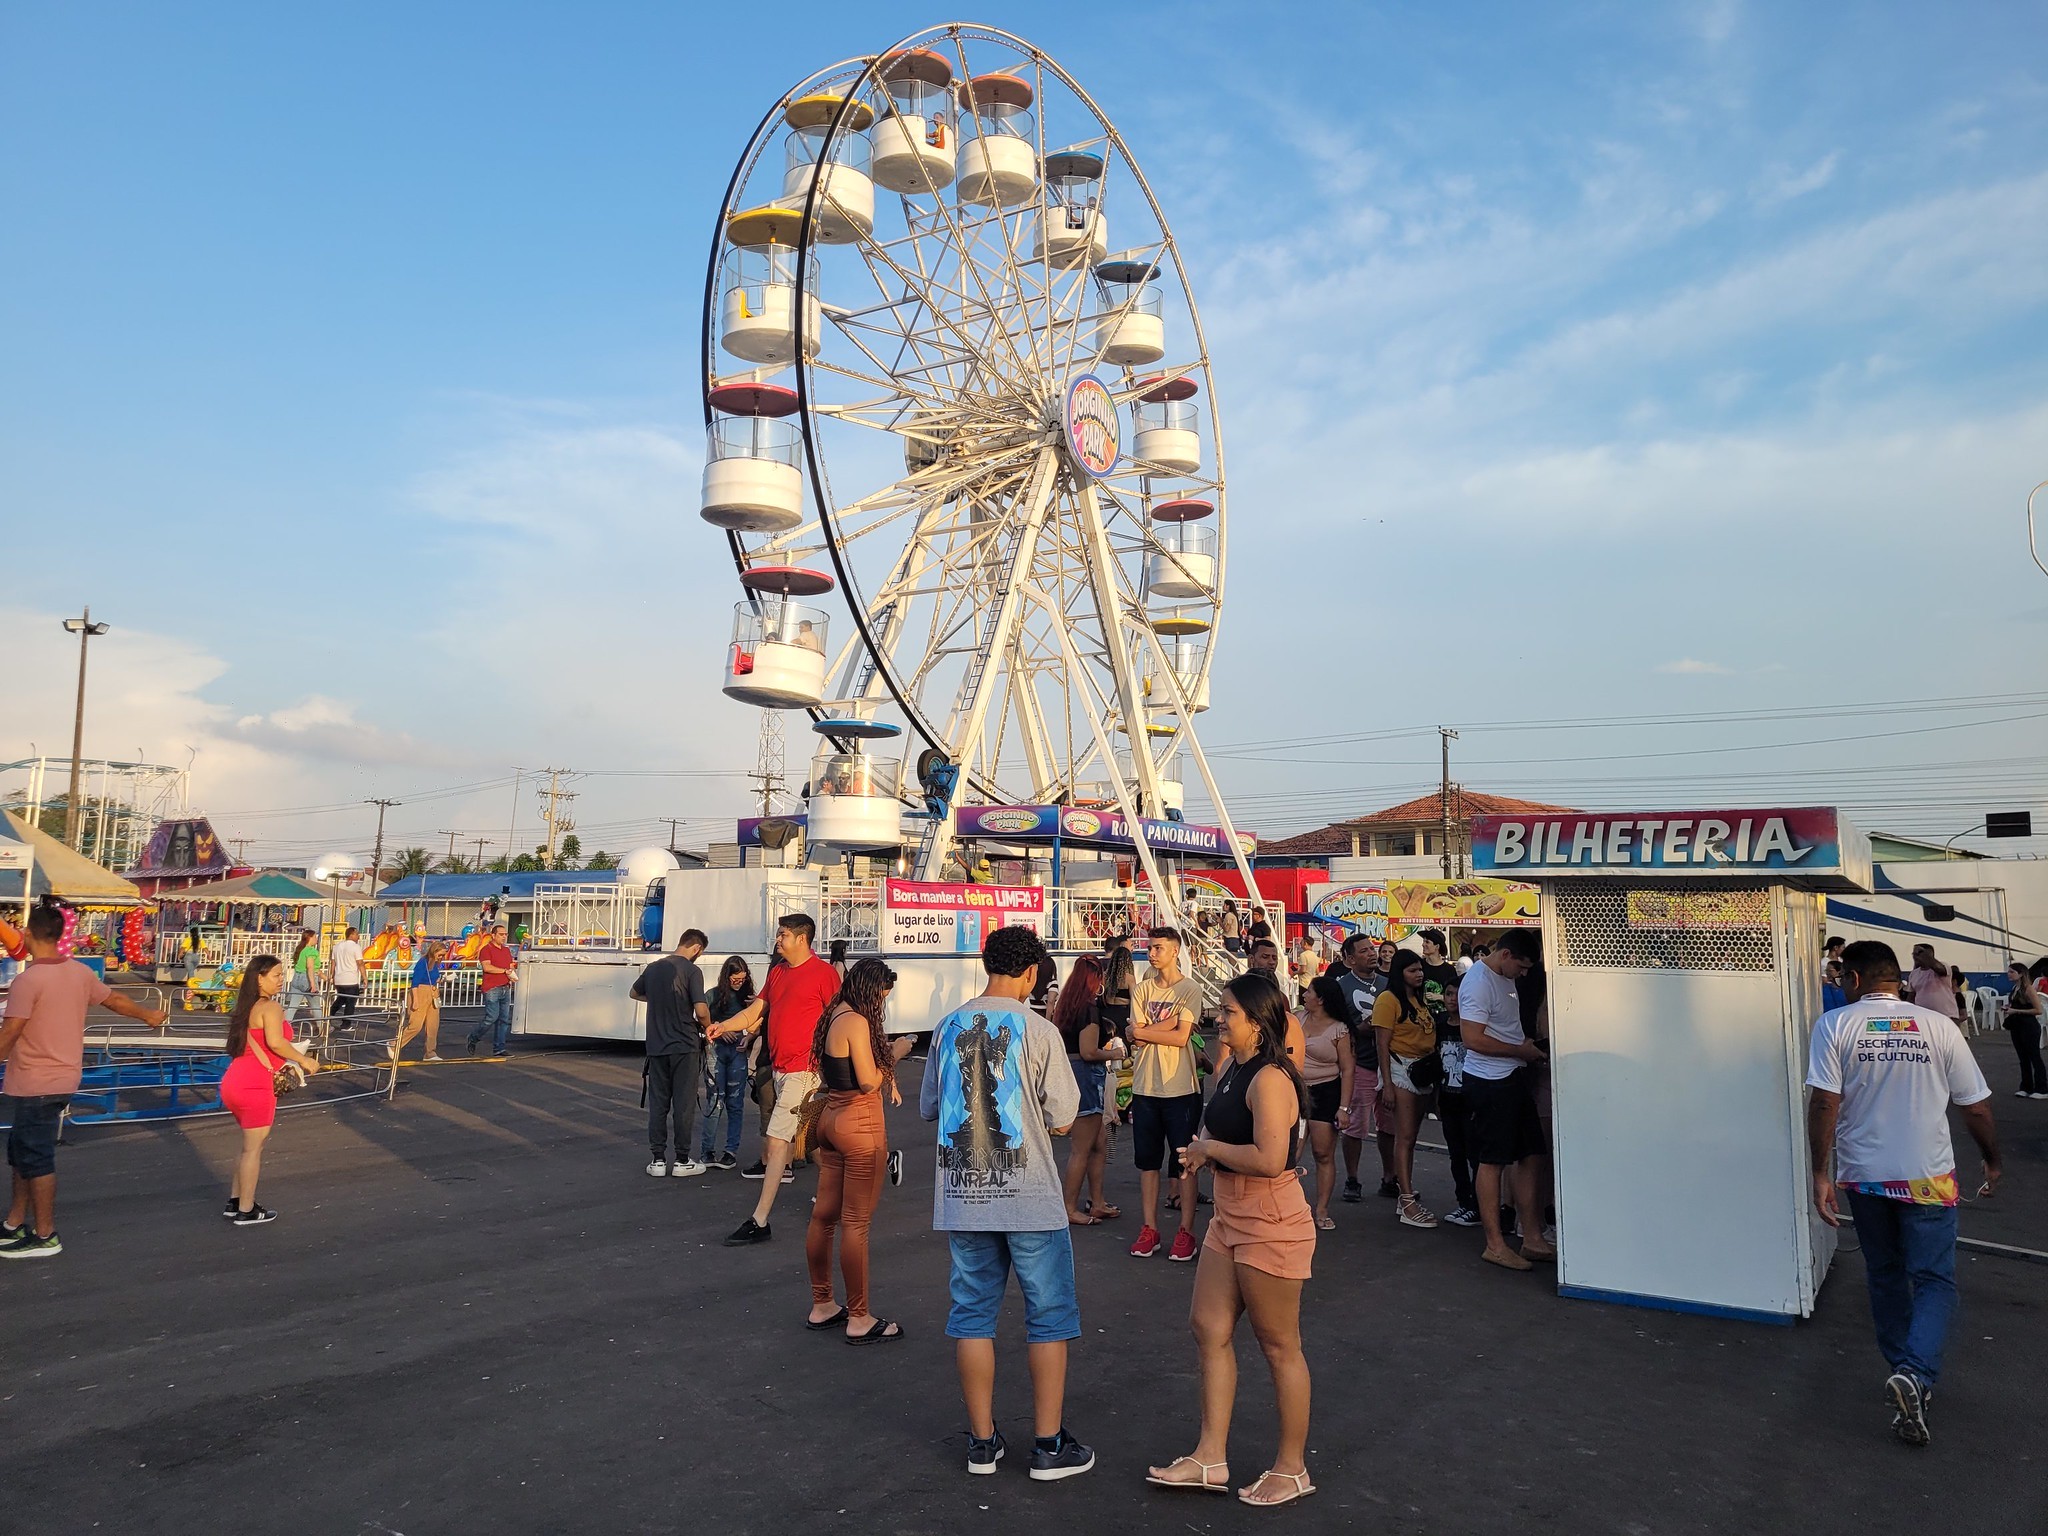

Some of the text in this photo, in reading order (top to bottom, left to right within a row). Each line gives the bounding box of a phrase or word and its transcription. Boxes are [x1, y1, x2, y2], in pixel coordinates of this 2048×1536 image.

[1073, 388, 1117, 443] JORGINHO
[1083, 423, 1105, 464] PARK
[984, 810, 1036, 823] JORGINHO
[1067, 813, 1098, 827] JORGINHO
[996, 820, 1021, 830] PARK
[1074, 822, 1089, 833] PARK
[1148, 825, 1217, 848] PANORAMICA
[1494, 818, 1814, 863] BILHETERIA
[893, 888, 919, 903] Bora
[920, 891, 956, 904] manter
[957, 895, 964, 904] a
[964, 889, 994, 906] feira
[1325, 893, 1388, 918] JORGIN
[894, 913, 954, 928] lugar de lixo
[894, 932, 941, 944] é no LIXO.
[1857, 1039, 1930, 1050] SECRETARIA
[1858, 1052, 1932, 1064] DE CULTURA
[950, 1170, 1009, 1188] UNREAL
